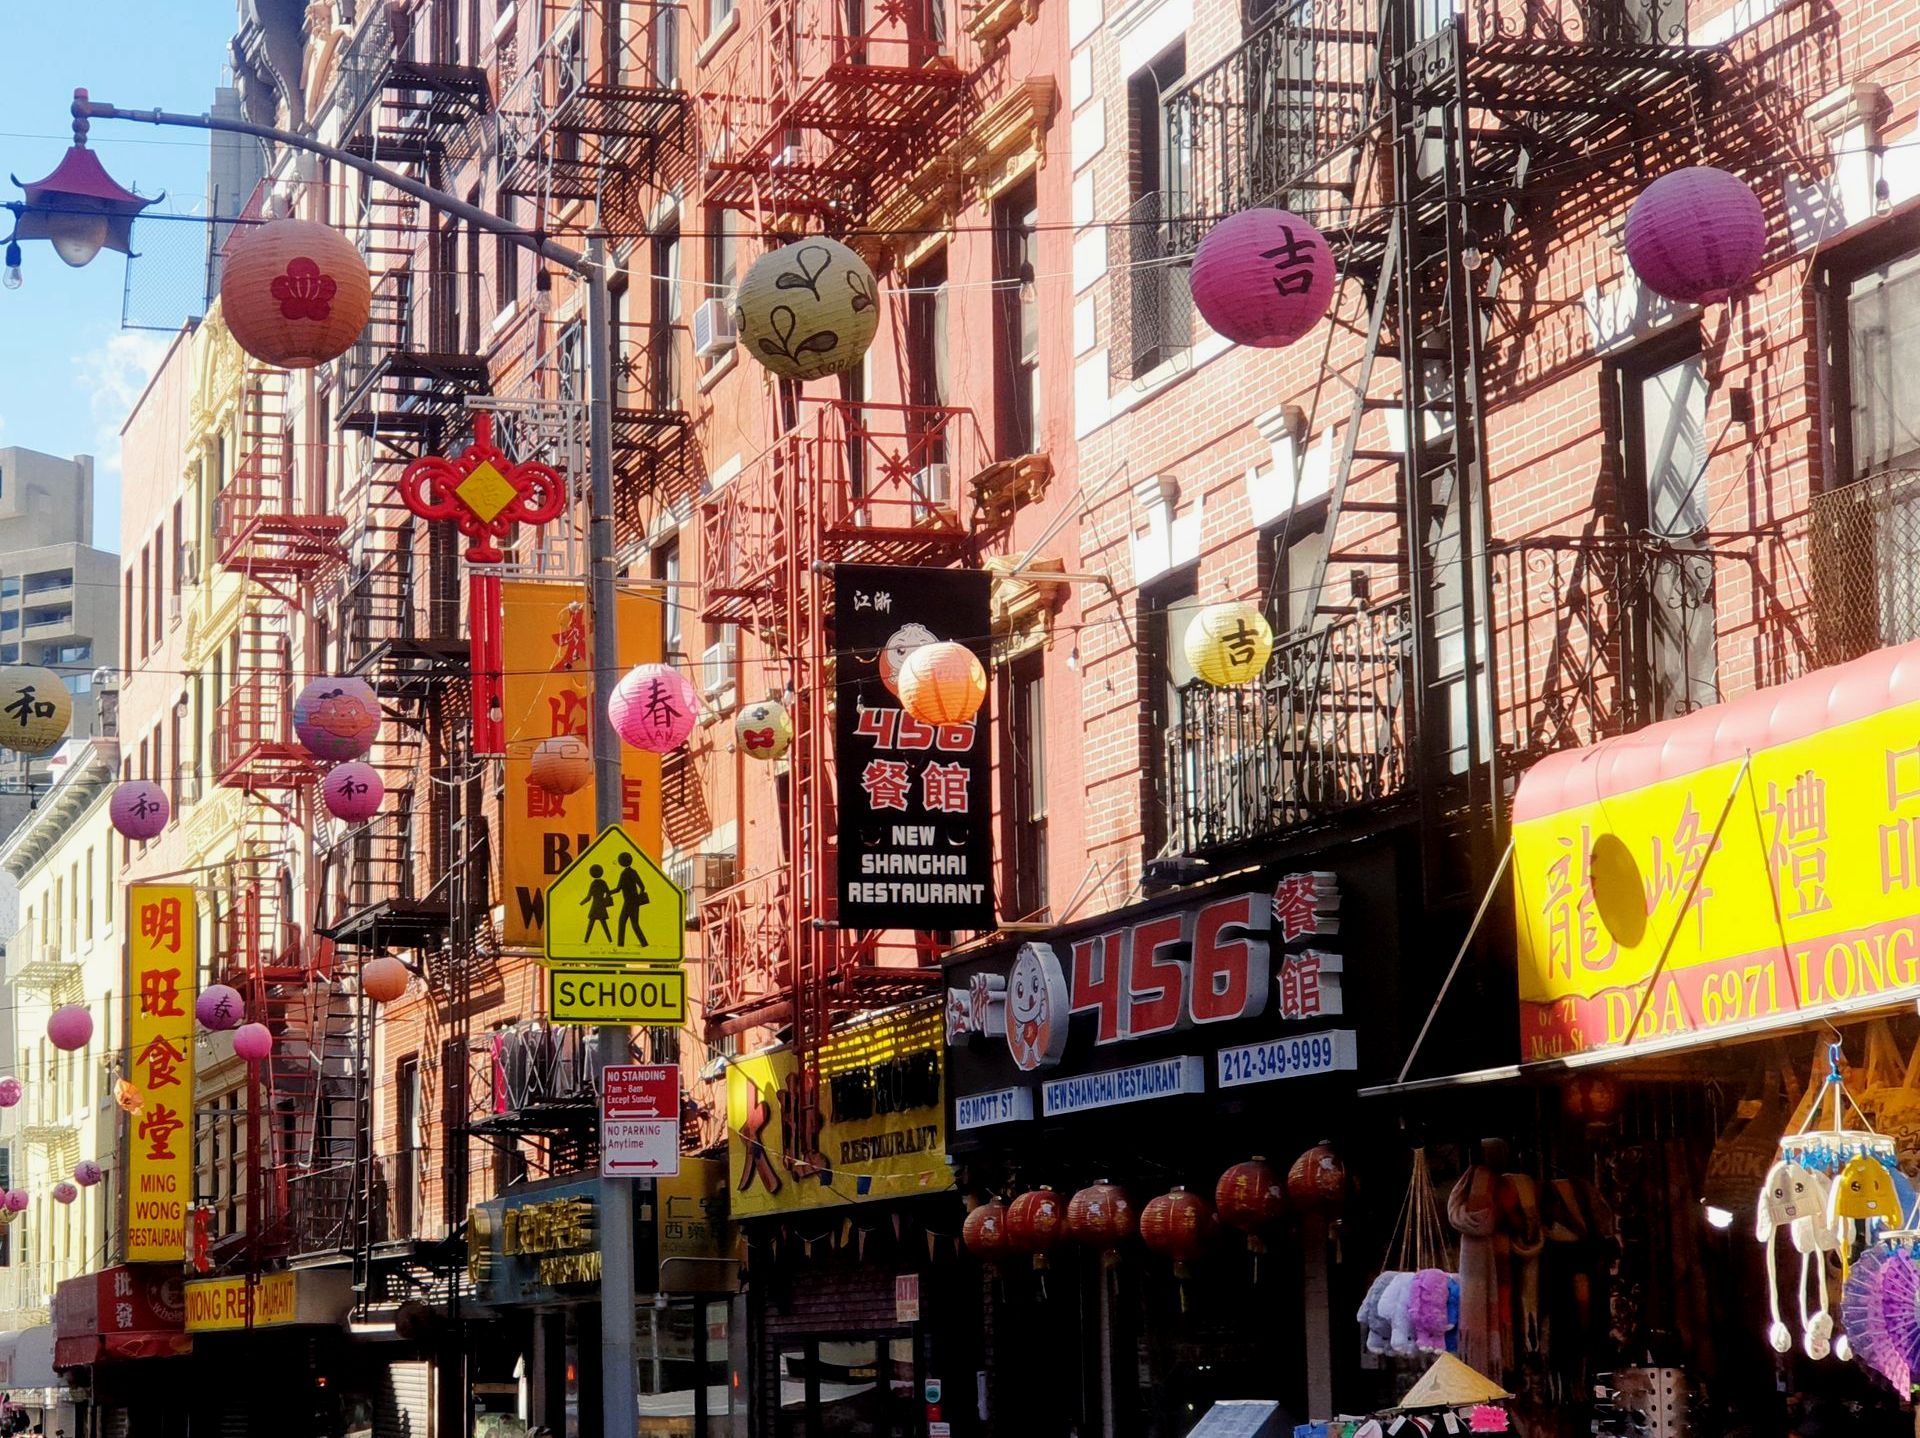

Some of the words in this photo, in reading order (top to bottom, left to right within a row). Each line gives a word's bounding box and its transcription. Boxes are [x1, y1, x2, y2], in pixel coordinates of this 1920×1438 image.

[1260, 225, 1316, 296] 吉
[1219, 618, 1259, 667] 吉
[4, 686, 56, 727] 和
[641, 679, 682, 728] 春
[854, 707, 978, 752] 456
[338, 775, 369, 801] 和
[861, 759, 970, 813] 餐館
[129, 793, 160, 820] 和
[892, 826, 935, 846] NEW
[861, 855, 966, 875] SHANGHAI
[849, 883, 984, 904] RESTAURANT
[1272, 872, 1321, 1020] 餐館
[1069, 892, 1256, 1046] 456
[559, 981, 677, 1008] SCHOOL
[1605, 981, 1685, 1045] DBA
[1701, 959, 1778, 1027] 6971
[1795, 927, 1918, 1008] LONG
[136, 897, 185, 1160] 明旺食堂
[607, 1071, 620, 1082] NO
[622, 1070, 666, 1081] STANDING
[607, 1085, 622, 1093] 7am
[628, 1084, 643, 1093] 8am
[1047, 1083, 1067, 1111] NEW
[1069, 1073, 1116, 1108] SHANGHAI
[1117, 1064, 1182, 1099] RESTAURANT
[607, 1095, 630, 1105] Except
[632, 1095, 656, 1104] Sunday
[960, 1101, 971, 1124] 69
[973, 1095, 998, 1122] MOTT
[1002, 1093, 1013, 1117] ST
[607, 1126, 620, 1136] NO
[623, 1125, 661, 1136] PARKING
[608, 1138, 644, 1150] Anytime
[840, 1125, 938, 1165] RESTAURANT
[141, 1174, 176, 1193] MING
[136, 1201, 180, 1220] WONG
[129, 1227, 185, 1247] RESTAURAN
[115, 1271, 133, 1329] 批發
